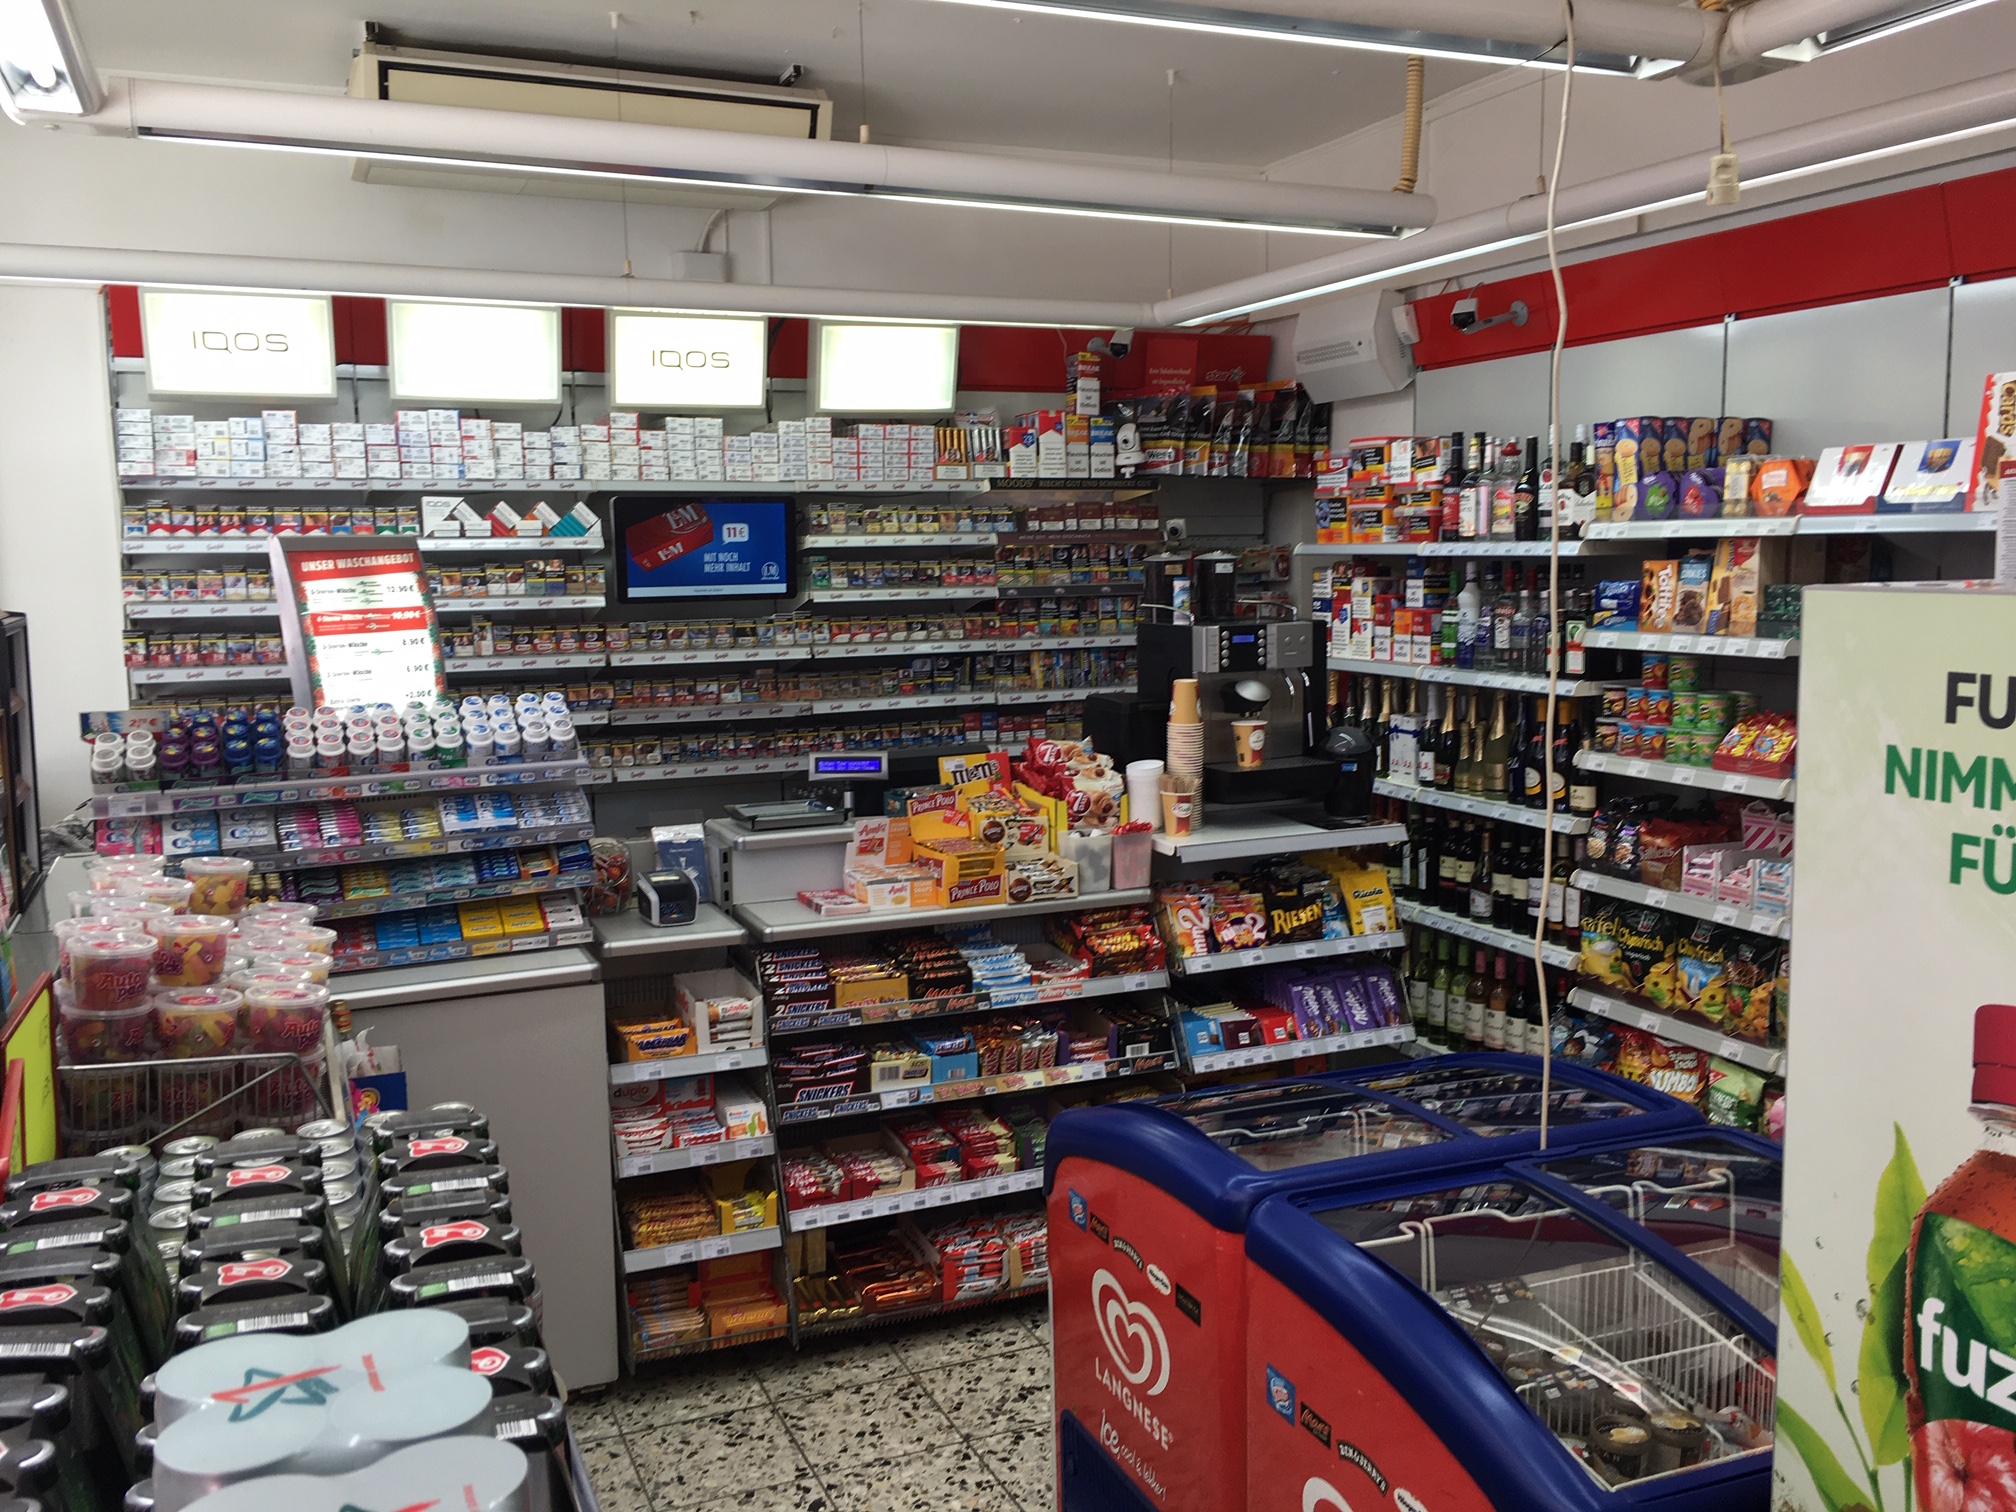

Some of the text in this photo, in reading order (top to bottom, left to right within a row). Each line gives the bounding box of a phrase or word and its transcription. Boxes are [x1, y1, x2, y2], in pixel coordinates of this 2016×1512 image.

[191, 330, 290, 354] IQOS
[651, 349, 730, 371] IQOS
[301, 553, 415, 572] UNSER WASCHANGEBOT
[719, 552, 739, 562] NOCH
[704, 562, 750, 573] MEHR INHALT
[1653, 564, 1674, 629] Toffifee
[912, 794, 956, 812] PRINCE POLO
[950, 879, 1000, 902] PRINCE POLO
[1352, 886, 1384, 899] Ricola
[1271, 903, 1323, 935] RIESEN
[97, 971, 142, 990] Auto
[774, 1002, 827, 1016] 2 SNICKERS
[280, 1020, 320, 1038] Auto
[613, 1084, 649, 1098] duplo
[798, 1084, 851, 1101] SNICKERS
[785, 1106, 818, 1121] SNICKERS
[1095, 1357, 1169, 1451] LANGNESE
